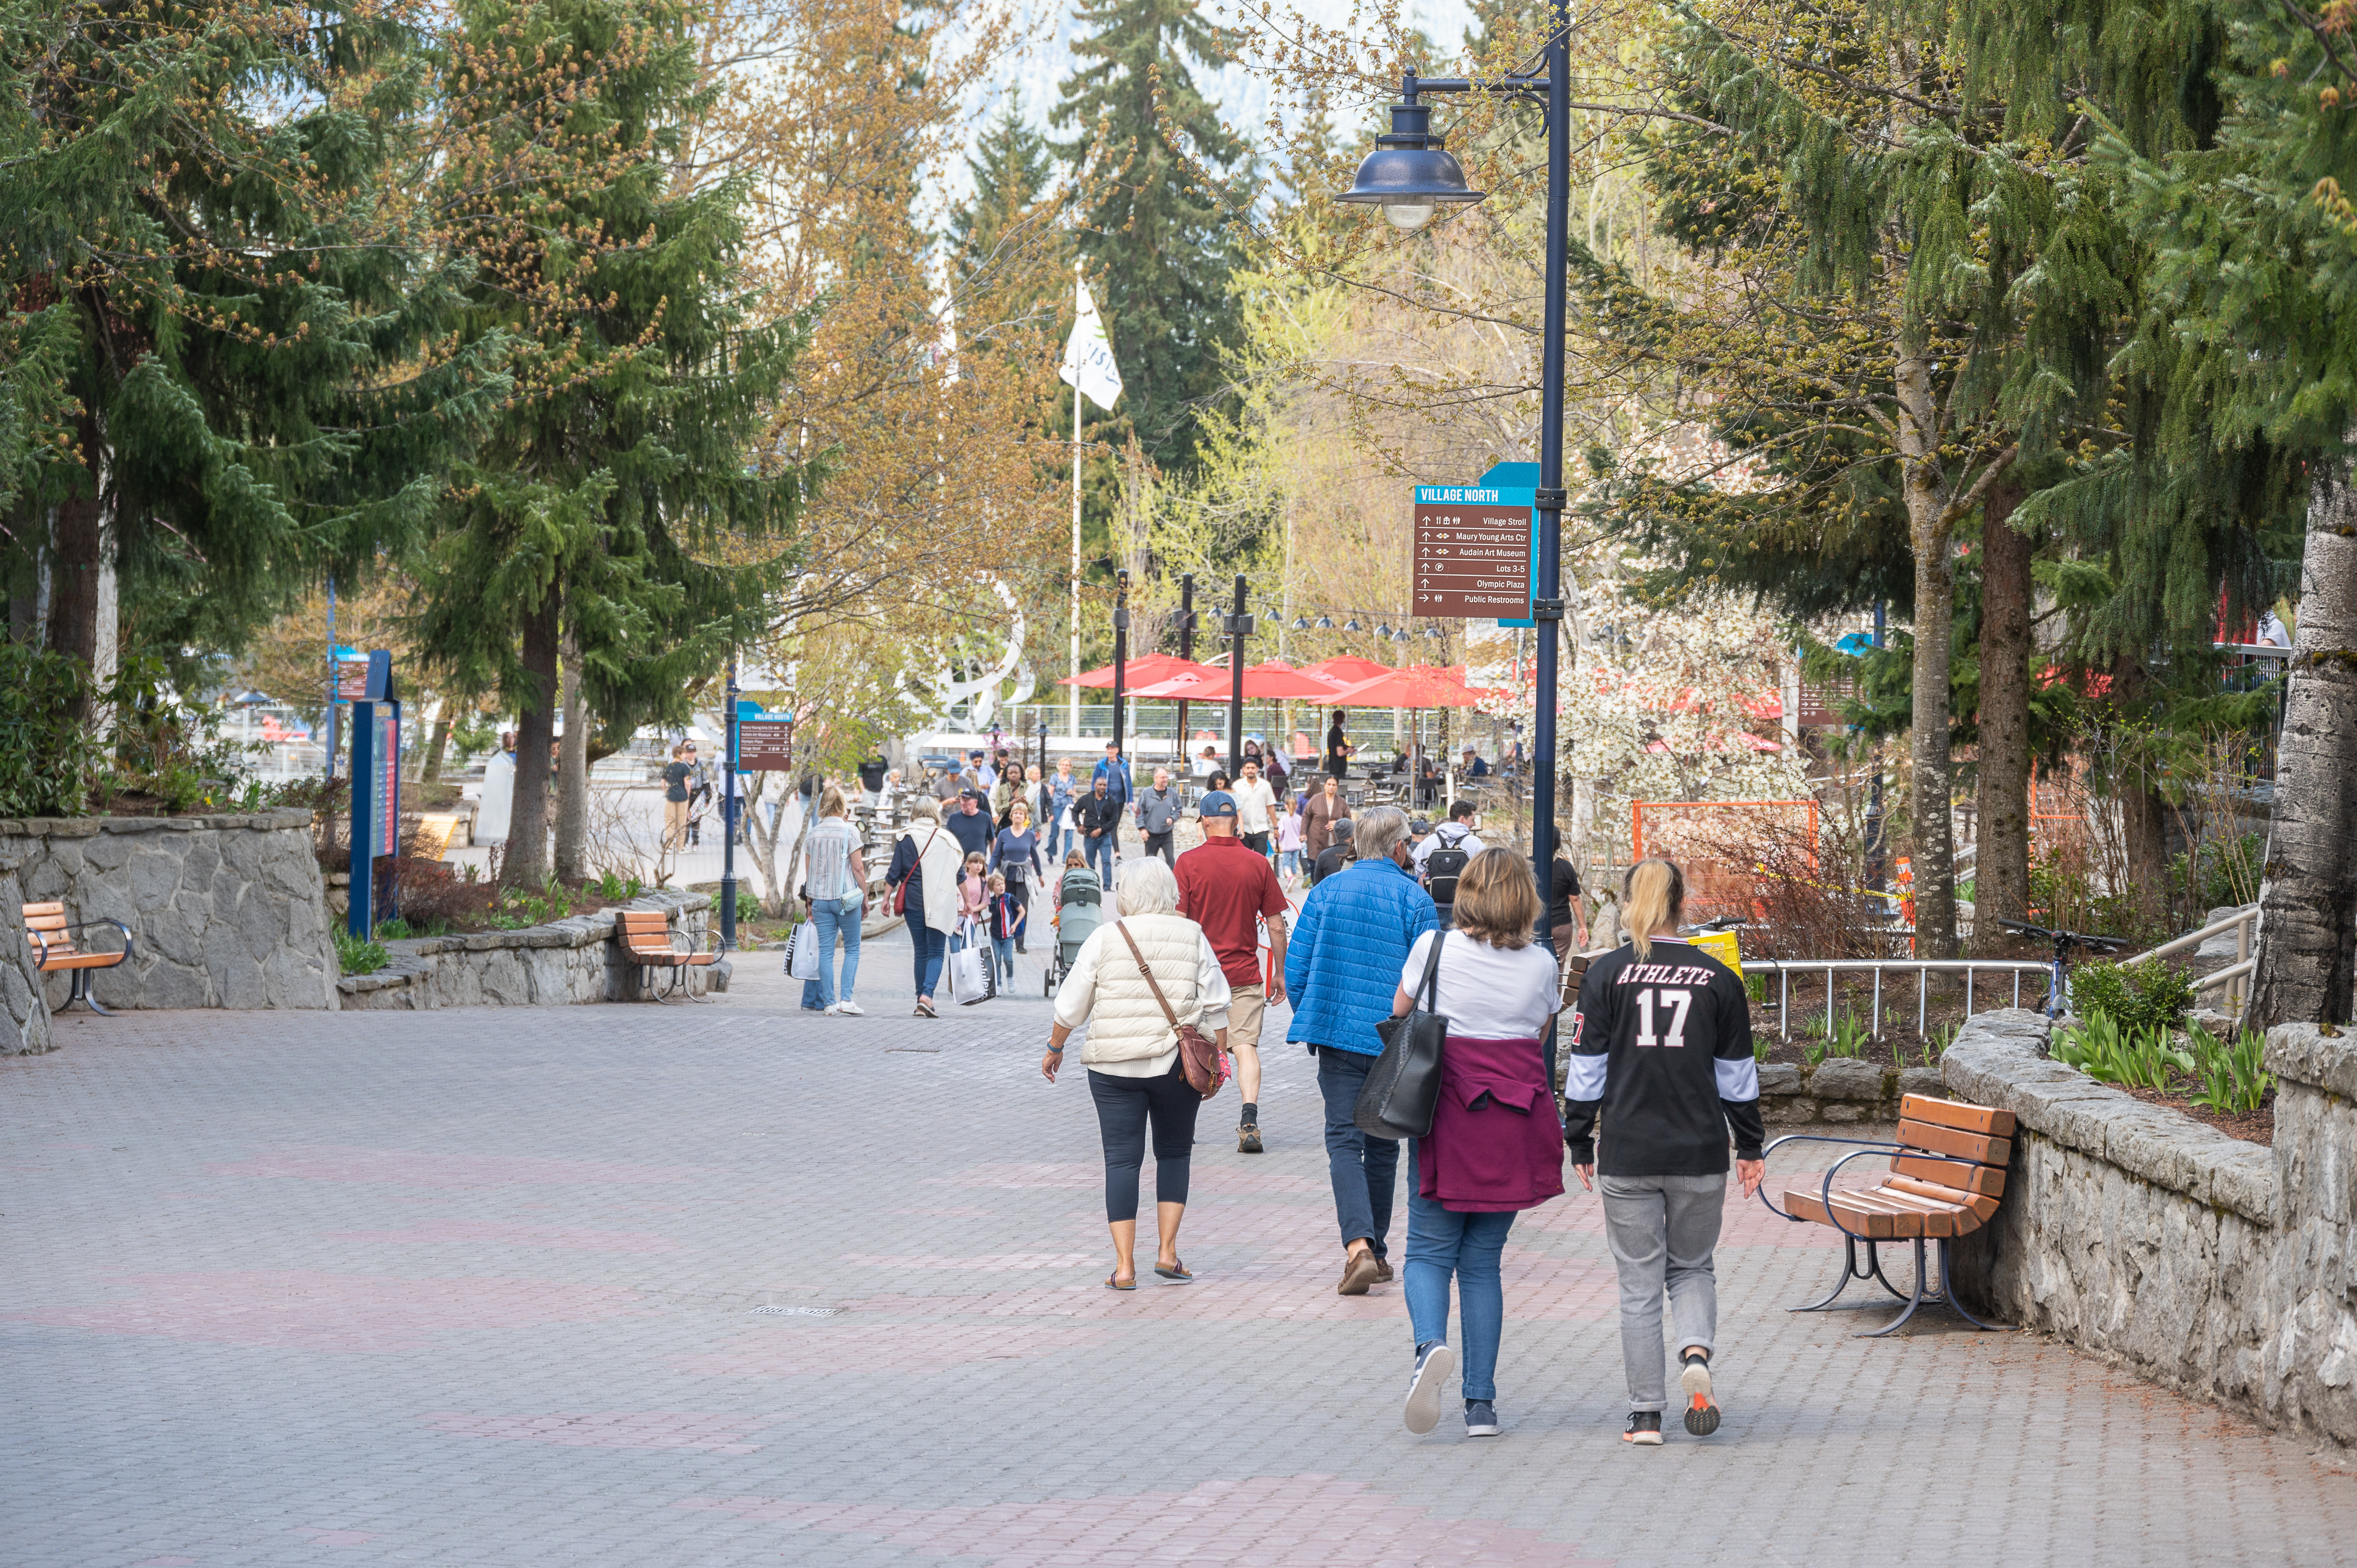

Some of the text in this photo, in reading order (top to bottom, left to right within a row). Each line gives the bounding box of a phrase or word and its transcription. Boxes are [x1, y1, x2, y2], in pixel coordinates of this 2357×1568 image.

[1421, 488, 1498, 502] VILLAGE NORTH
[1483, 517, 1506, 526] Village
[1456, 533, 1478, 542] Maury
[1478, 533, 1499, 542] Young
[1477, 580, 1505, 589] Olympic
[1617, 964, 1716, 986] ATHLETE
[1636, 988, 1692, 1047] 17
